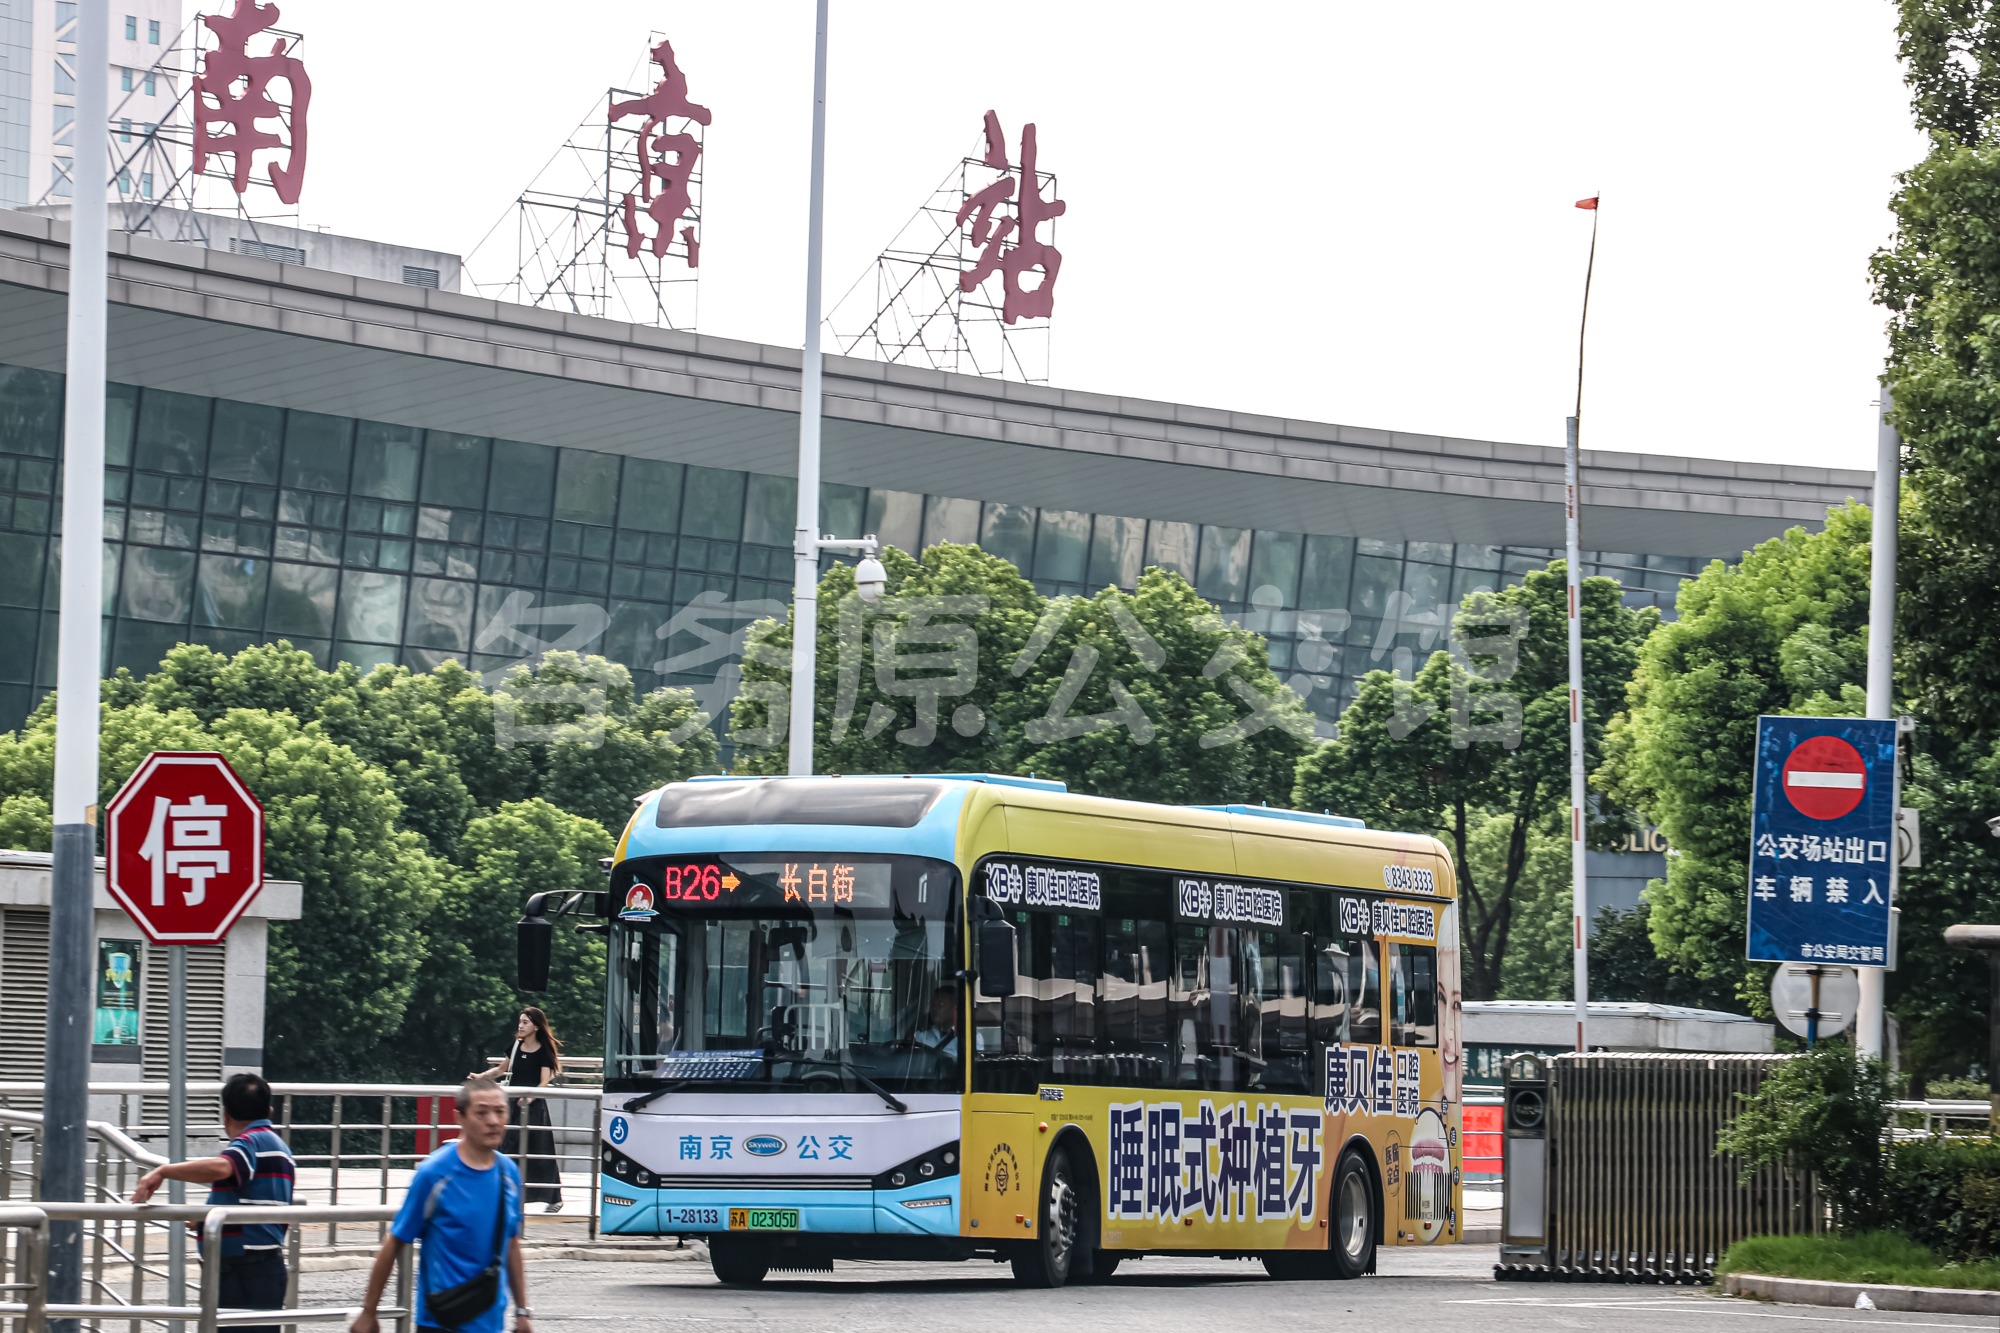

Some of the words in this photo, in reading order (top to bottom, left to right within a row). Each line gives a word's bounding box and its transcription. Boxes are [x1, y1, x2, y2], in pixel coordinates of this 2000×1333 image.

[138, 795, 230, 906] 停
[1755, 834, 1887, 864] 公交场站出口
[665, 864, 721, 901] B26
[780, 863, 856, 902] 长白街
[1026, 867, 1100, 909] 康贝佳口腔医院
[1391, 865, 1412, 891] 8343
[1412, 868, 1434, 893] 3333
[1754, 875, 1885, 905] 车辆禁入
[1215, 884, 1282, 925] 康贝佳口腔医院
[1373, 901, 1434, 939] 康贝佳口腔医院
[1801, 943, 1884, 961] 市公安局交管局
[1326, 1044, 1393, 1115] 康贝佳
[1396, 1051, 1419, 1081] 口腔
[1396, 1086, 1419, 1116] 医院
[679, 1135, 733, 1160] 南京
[797, 1135, 853, 1160] 公交
[1108, 1101, 1323, 1223] 睡眠式种植牙
[666, 1209, 718, 1224] 1-28133
